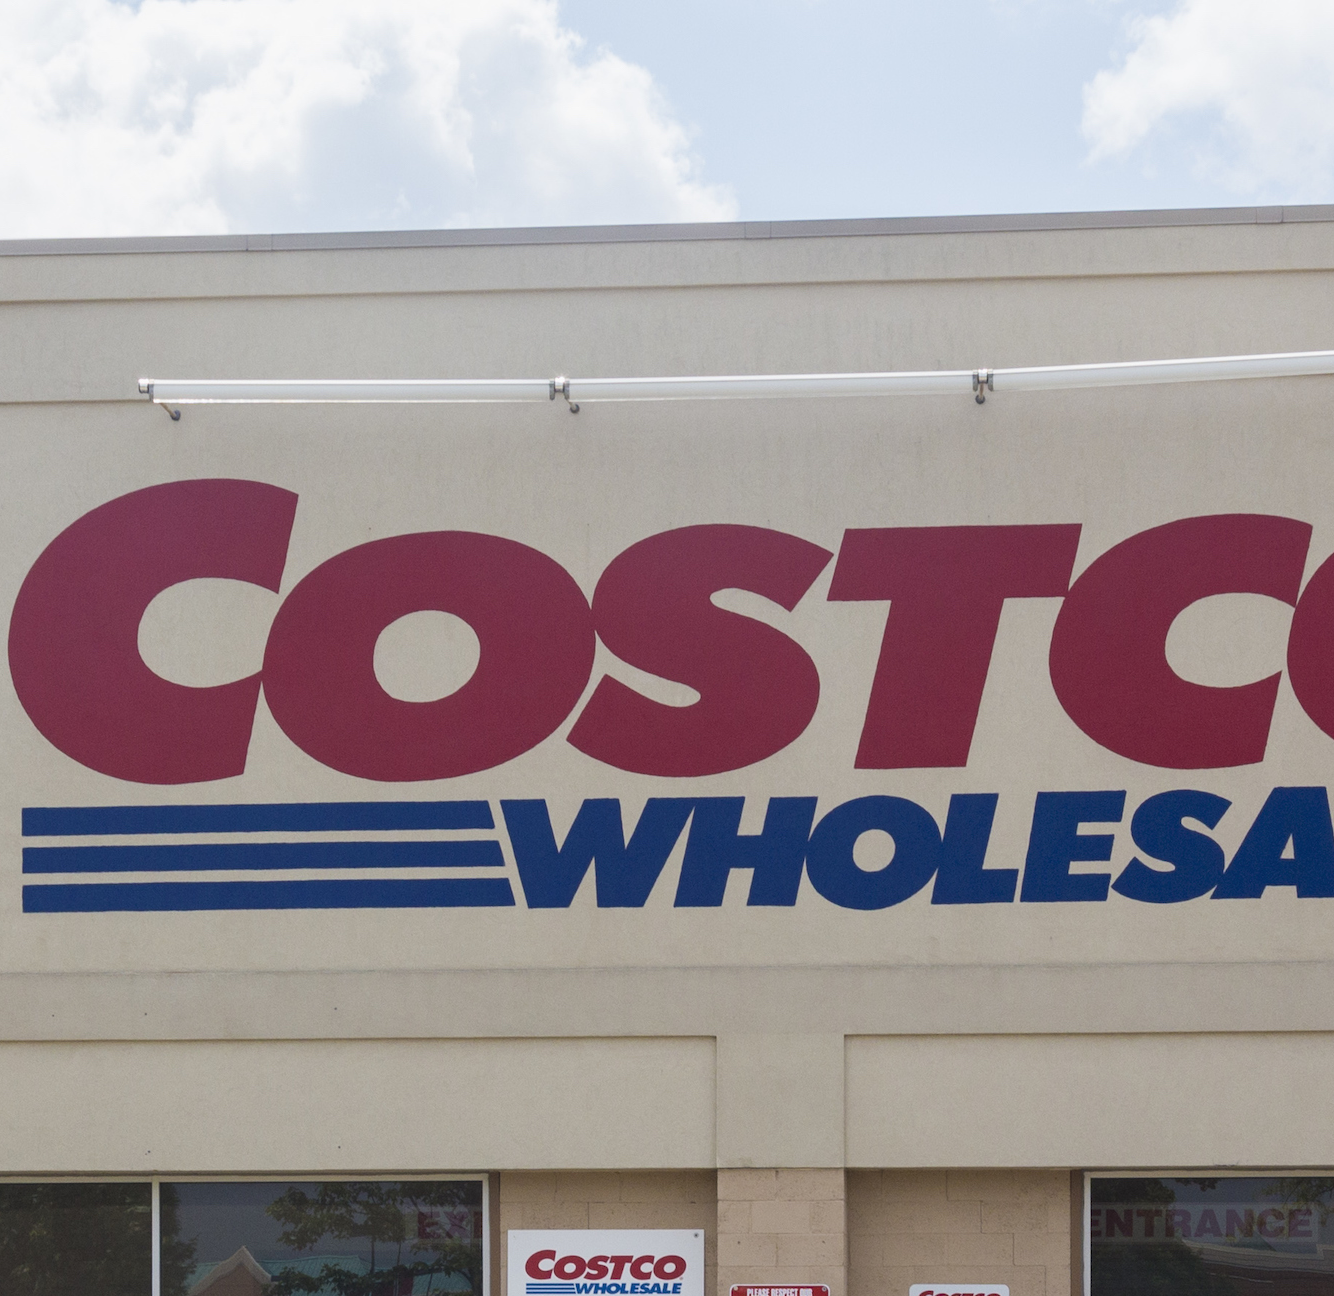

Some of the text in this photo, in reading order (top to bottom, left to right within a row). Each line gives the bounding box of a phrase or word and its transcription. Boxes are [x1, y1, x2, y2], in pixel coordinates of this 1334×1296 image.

[417, 1211, 482, 1238] EXI
[525, 1250, 687, 1280] COSTCO
[575, 1283, 682, 1295] WHOLESALE
